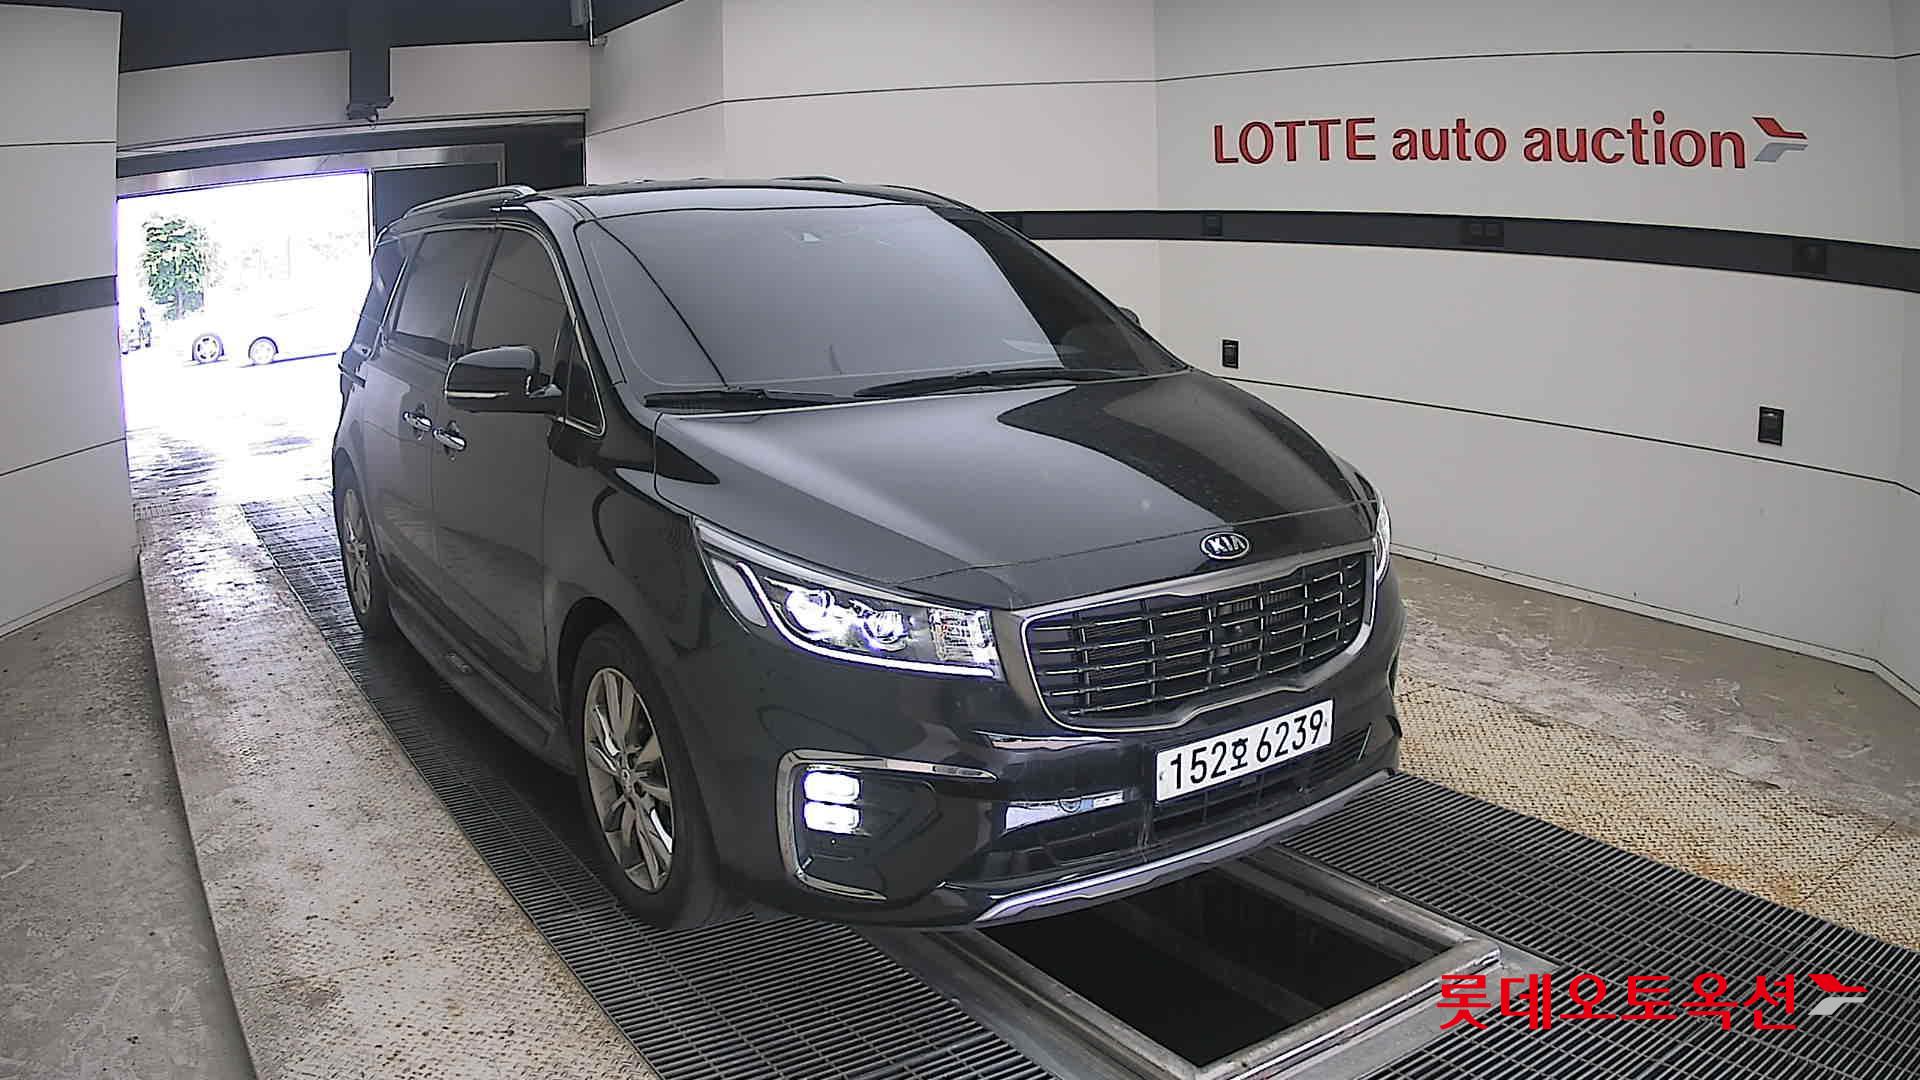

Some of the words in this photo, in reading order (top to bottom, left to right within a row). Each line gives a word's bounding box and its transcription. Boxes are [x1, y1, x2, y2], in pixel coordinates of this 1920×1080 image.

[1213, 117, 1376, 164] LOTTE
[1391, 117, 1508, 162] auto
[1522, 110, 1746, 169] auction
[1207, 535, 1246, 554] KIA
[1256, 709, 1324, 763] 6239
